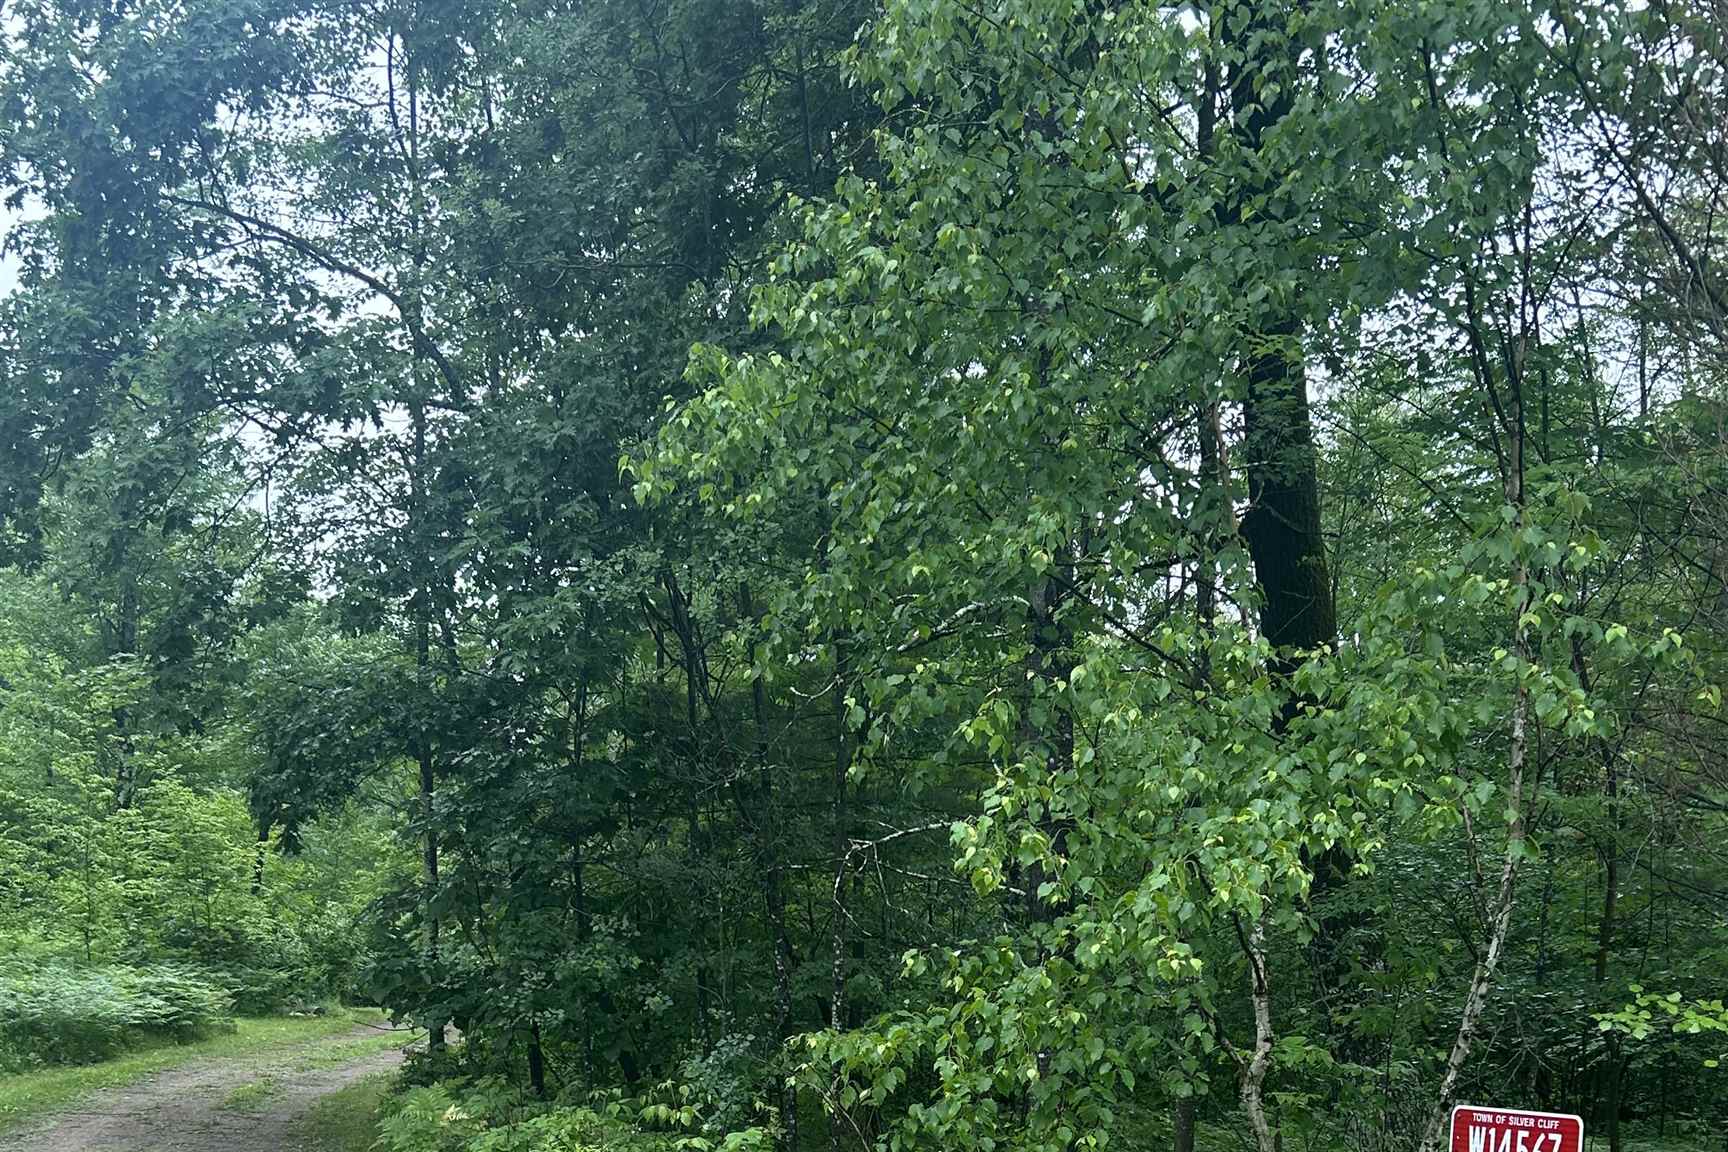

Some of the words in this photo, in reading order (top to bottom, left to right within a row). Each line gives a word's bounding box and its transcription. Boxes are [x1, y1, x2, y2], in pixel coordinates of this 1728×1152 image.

[1473, 1113, 1493, 1123] TOWN
[1495, 1115, 1506, 1124] OF
[1508, 1116, 1535, 1127] SILVER
[1537, 1119, 1560, 1129] CLIFF
